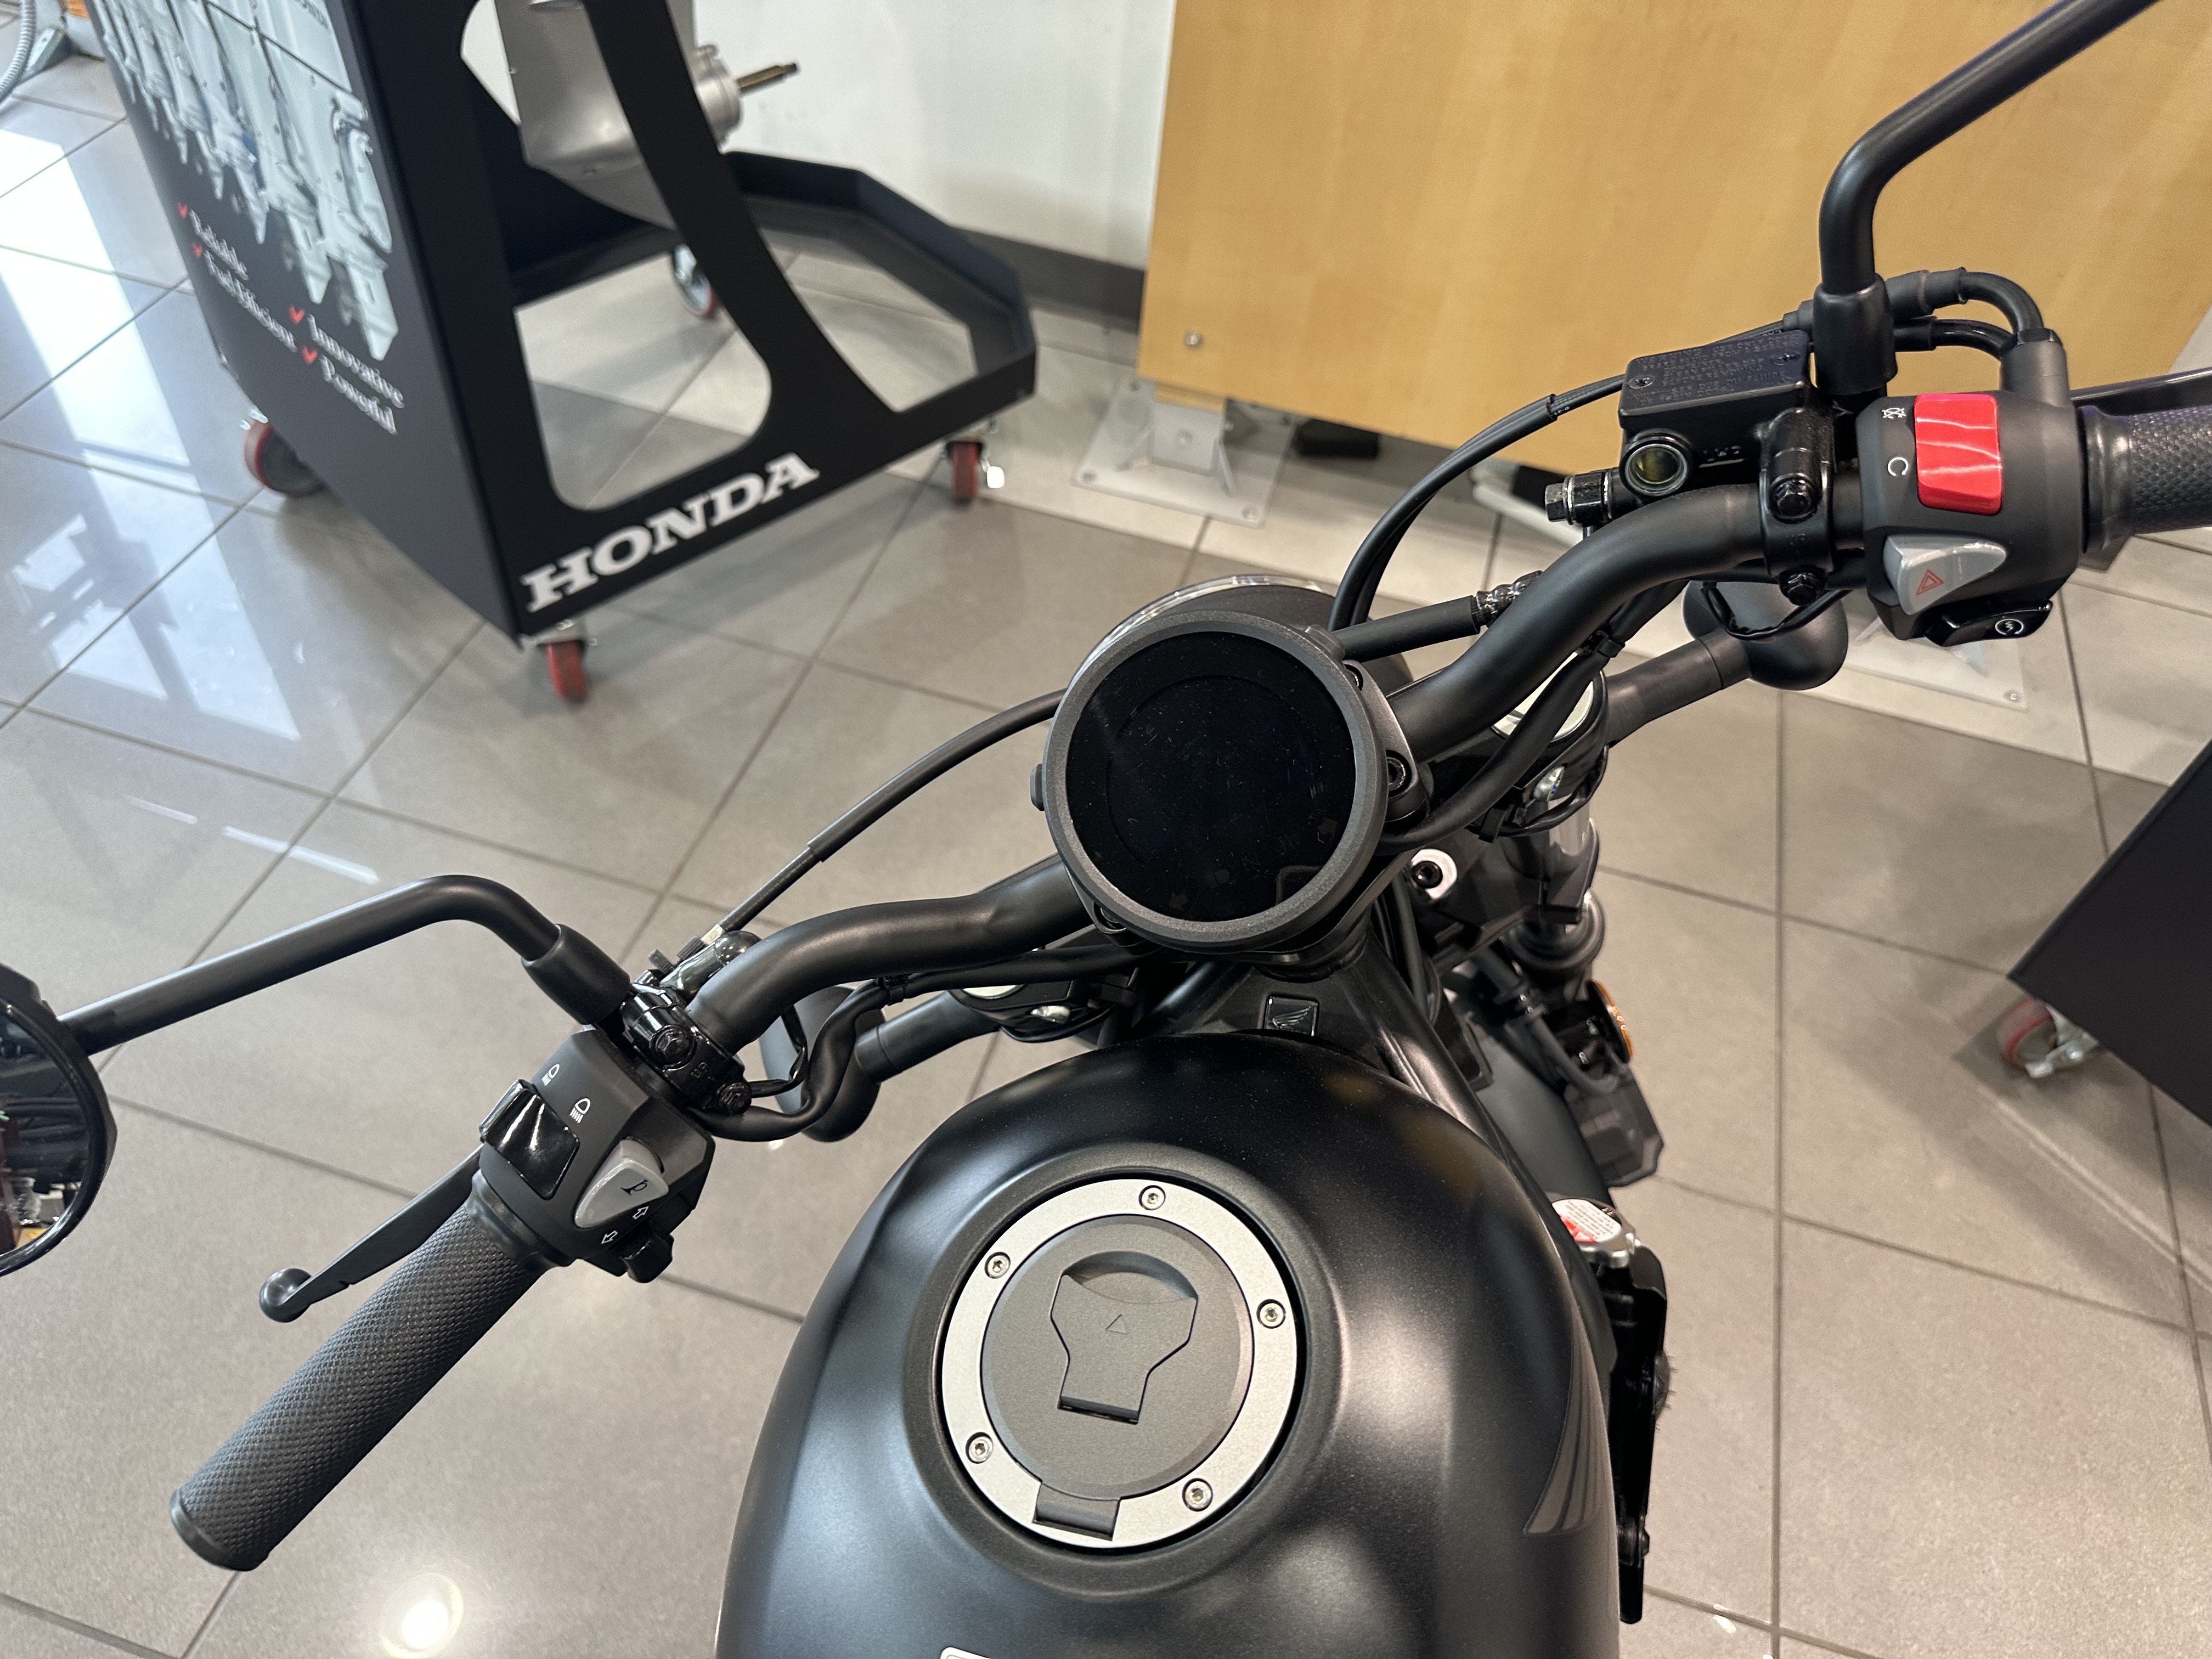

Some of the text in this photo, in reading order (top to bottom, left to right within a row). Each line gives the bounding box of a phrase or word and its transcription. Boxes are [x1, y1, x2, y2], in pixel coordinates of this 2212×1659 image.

[189, 208, 249, 280] Reliable
[307, 312, 405, 409] Innovative
[318, 354, 398, 435] Powerful
[520, 452, 820, 613] HONDA
